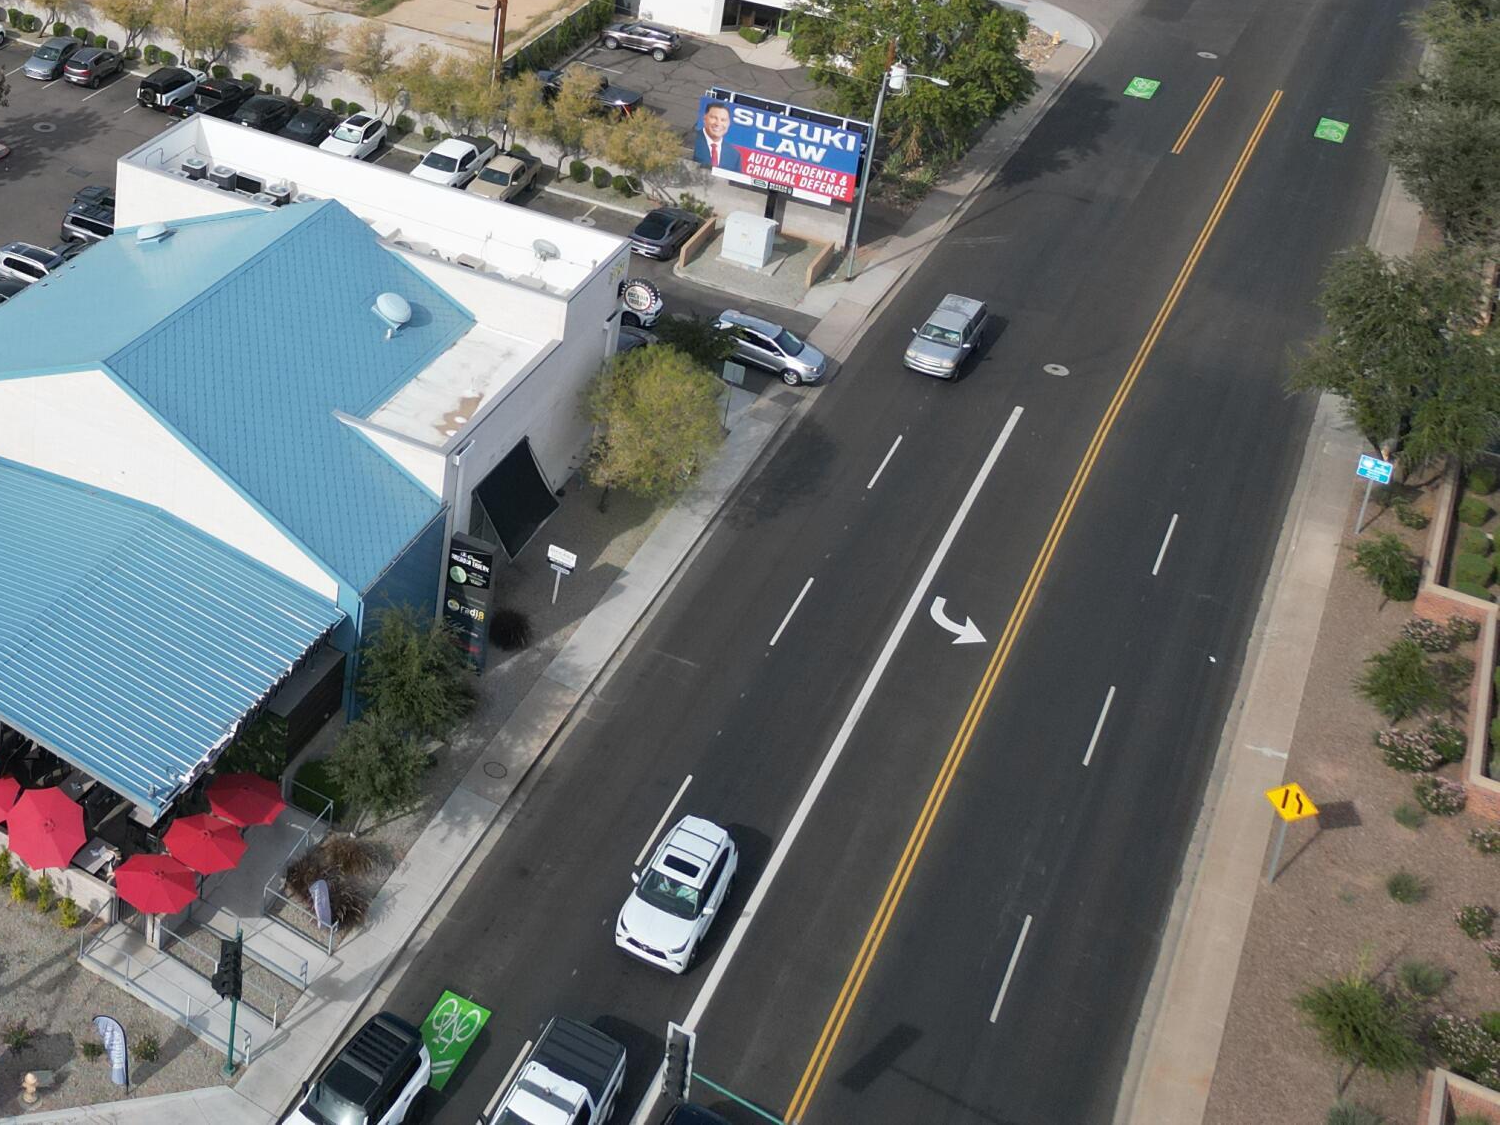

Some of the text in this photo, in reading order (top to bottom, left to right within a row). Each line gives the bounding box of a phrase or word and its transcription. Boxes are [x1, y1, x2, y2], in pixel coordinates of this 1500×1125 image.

[733, 107, 856, 152] SUZUKI
[755, 133, 827, 163] LAW
[746, 164, 796, 186] CRIMINAL
[799, 178, 848, 199] DEFENSE
[748, 154, 776, 169] AUTO
[778, 160, 838, 184] ACCIDENTS
[839, 174, 847, 186] &
